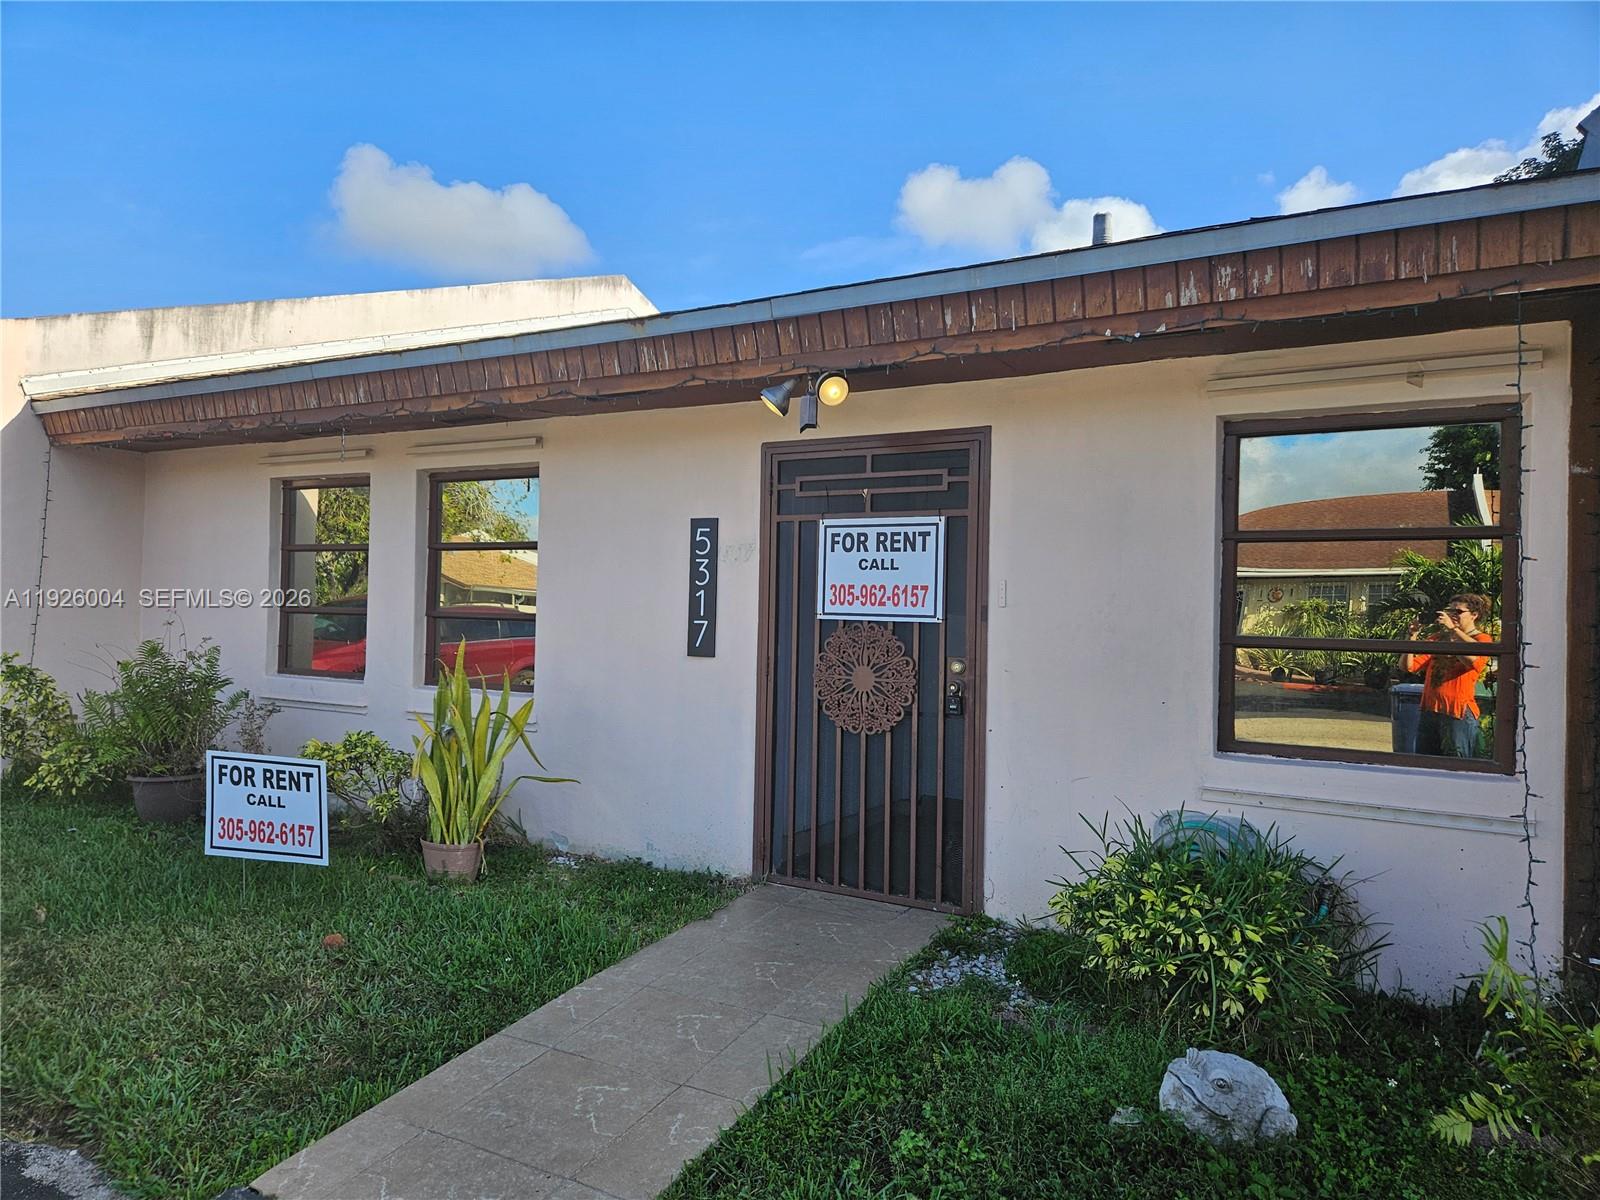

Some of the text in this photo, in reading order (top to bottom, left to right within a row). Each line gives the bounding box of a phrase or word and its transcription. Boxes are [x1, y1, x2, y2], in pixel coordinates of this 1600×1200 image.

[830, 531, 931, 553] FOR RENT
[858, 558, 900, 571] CALL
[693, 528, 711, 647] 5317
[829, 583, 929, 608] 305-962-6157
[218, 764, 314, 793] FOR RENT
[246, 793, 286, 809] CALL
[217, 816, 315, 848] 305-962-6157
